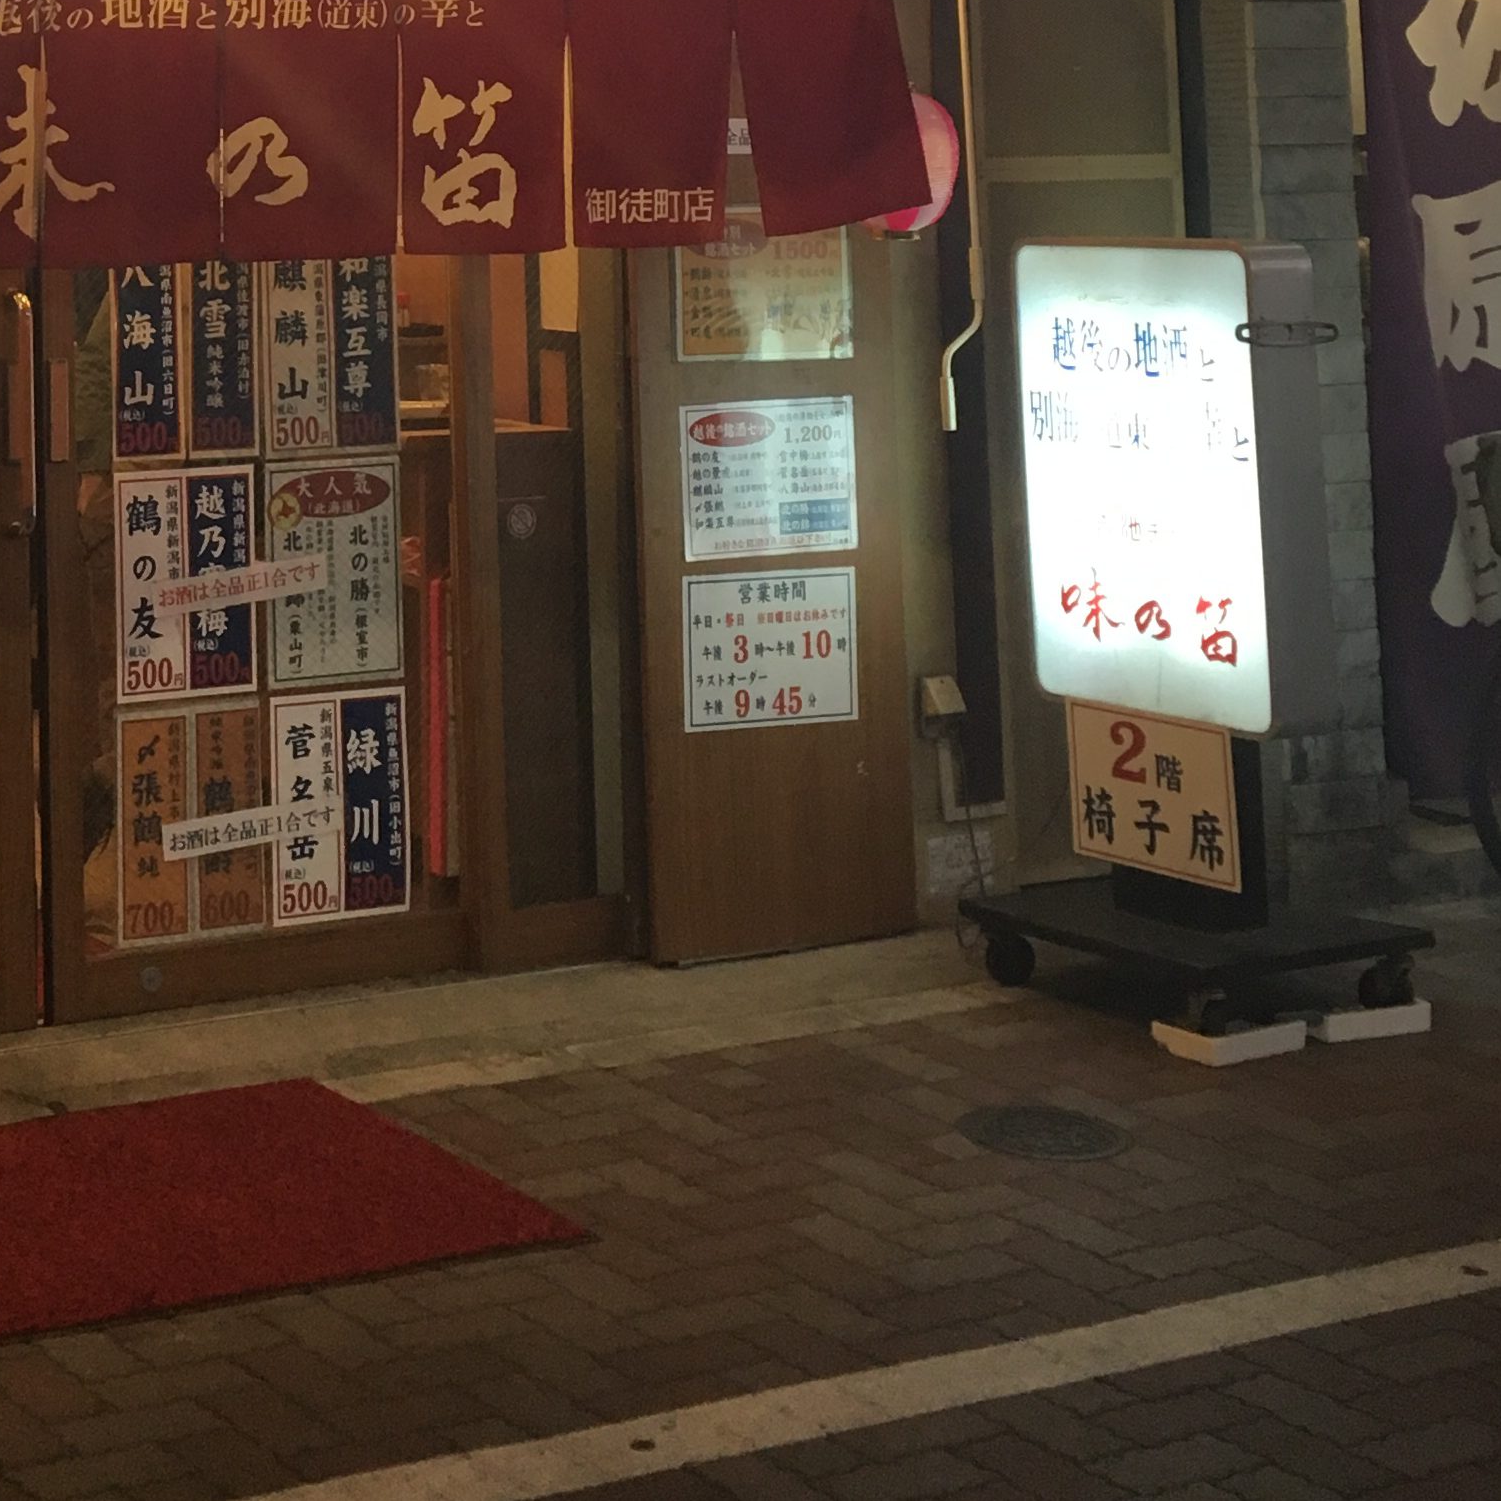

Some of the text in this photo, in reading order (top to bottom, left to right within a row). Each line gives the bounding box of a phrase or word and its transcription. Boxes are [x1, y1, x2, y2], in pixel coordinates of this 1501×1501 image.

[585, 186, 715, 225] 御徒町店
[120, 264, 157, 407] 八海山
[199, 261, 232, 340] 北雪
[338, 258, 373, 399] 和楽互尊
[274, 415, 330, 447] 500円
[297, 473, 374, 498] 大人気
[231, 479, 247, 568] 新潟県新潟
[125, 494, 164, 641] 鶴の友
[738, 580, 807, 605] 営業時間
[126, 656, 185, 690] 500円
[695, 669, 768, 688] ラストオーダー
[702, 685, 818, 719] 午後9時45分
[319, 707, 335, 793] 新潟県五泉
[346, 727, 383, 846] 緑川
[1109, 720, 1184, 794] 2階
[1082, 784, 1225, 872] 椅子席
[282, 879, 339, 914] 500円
